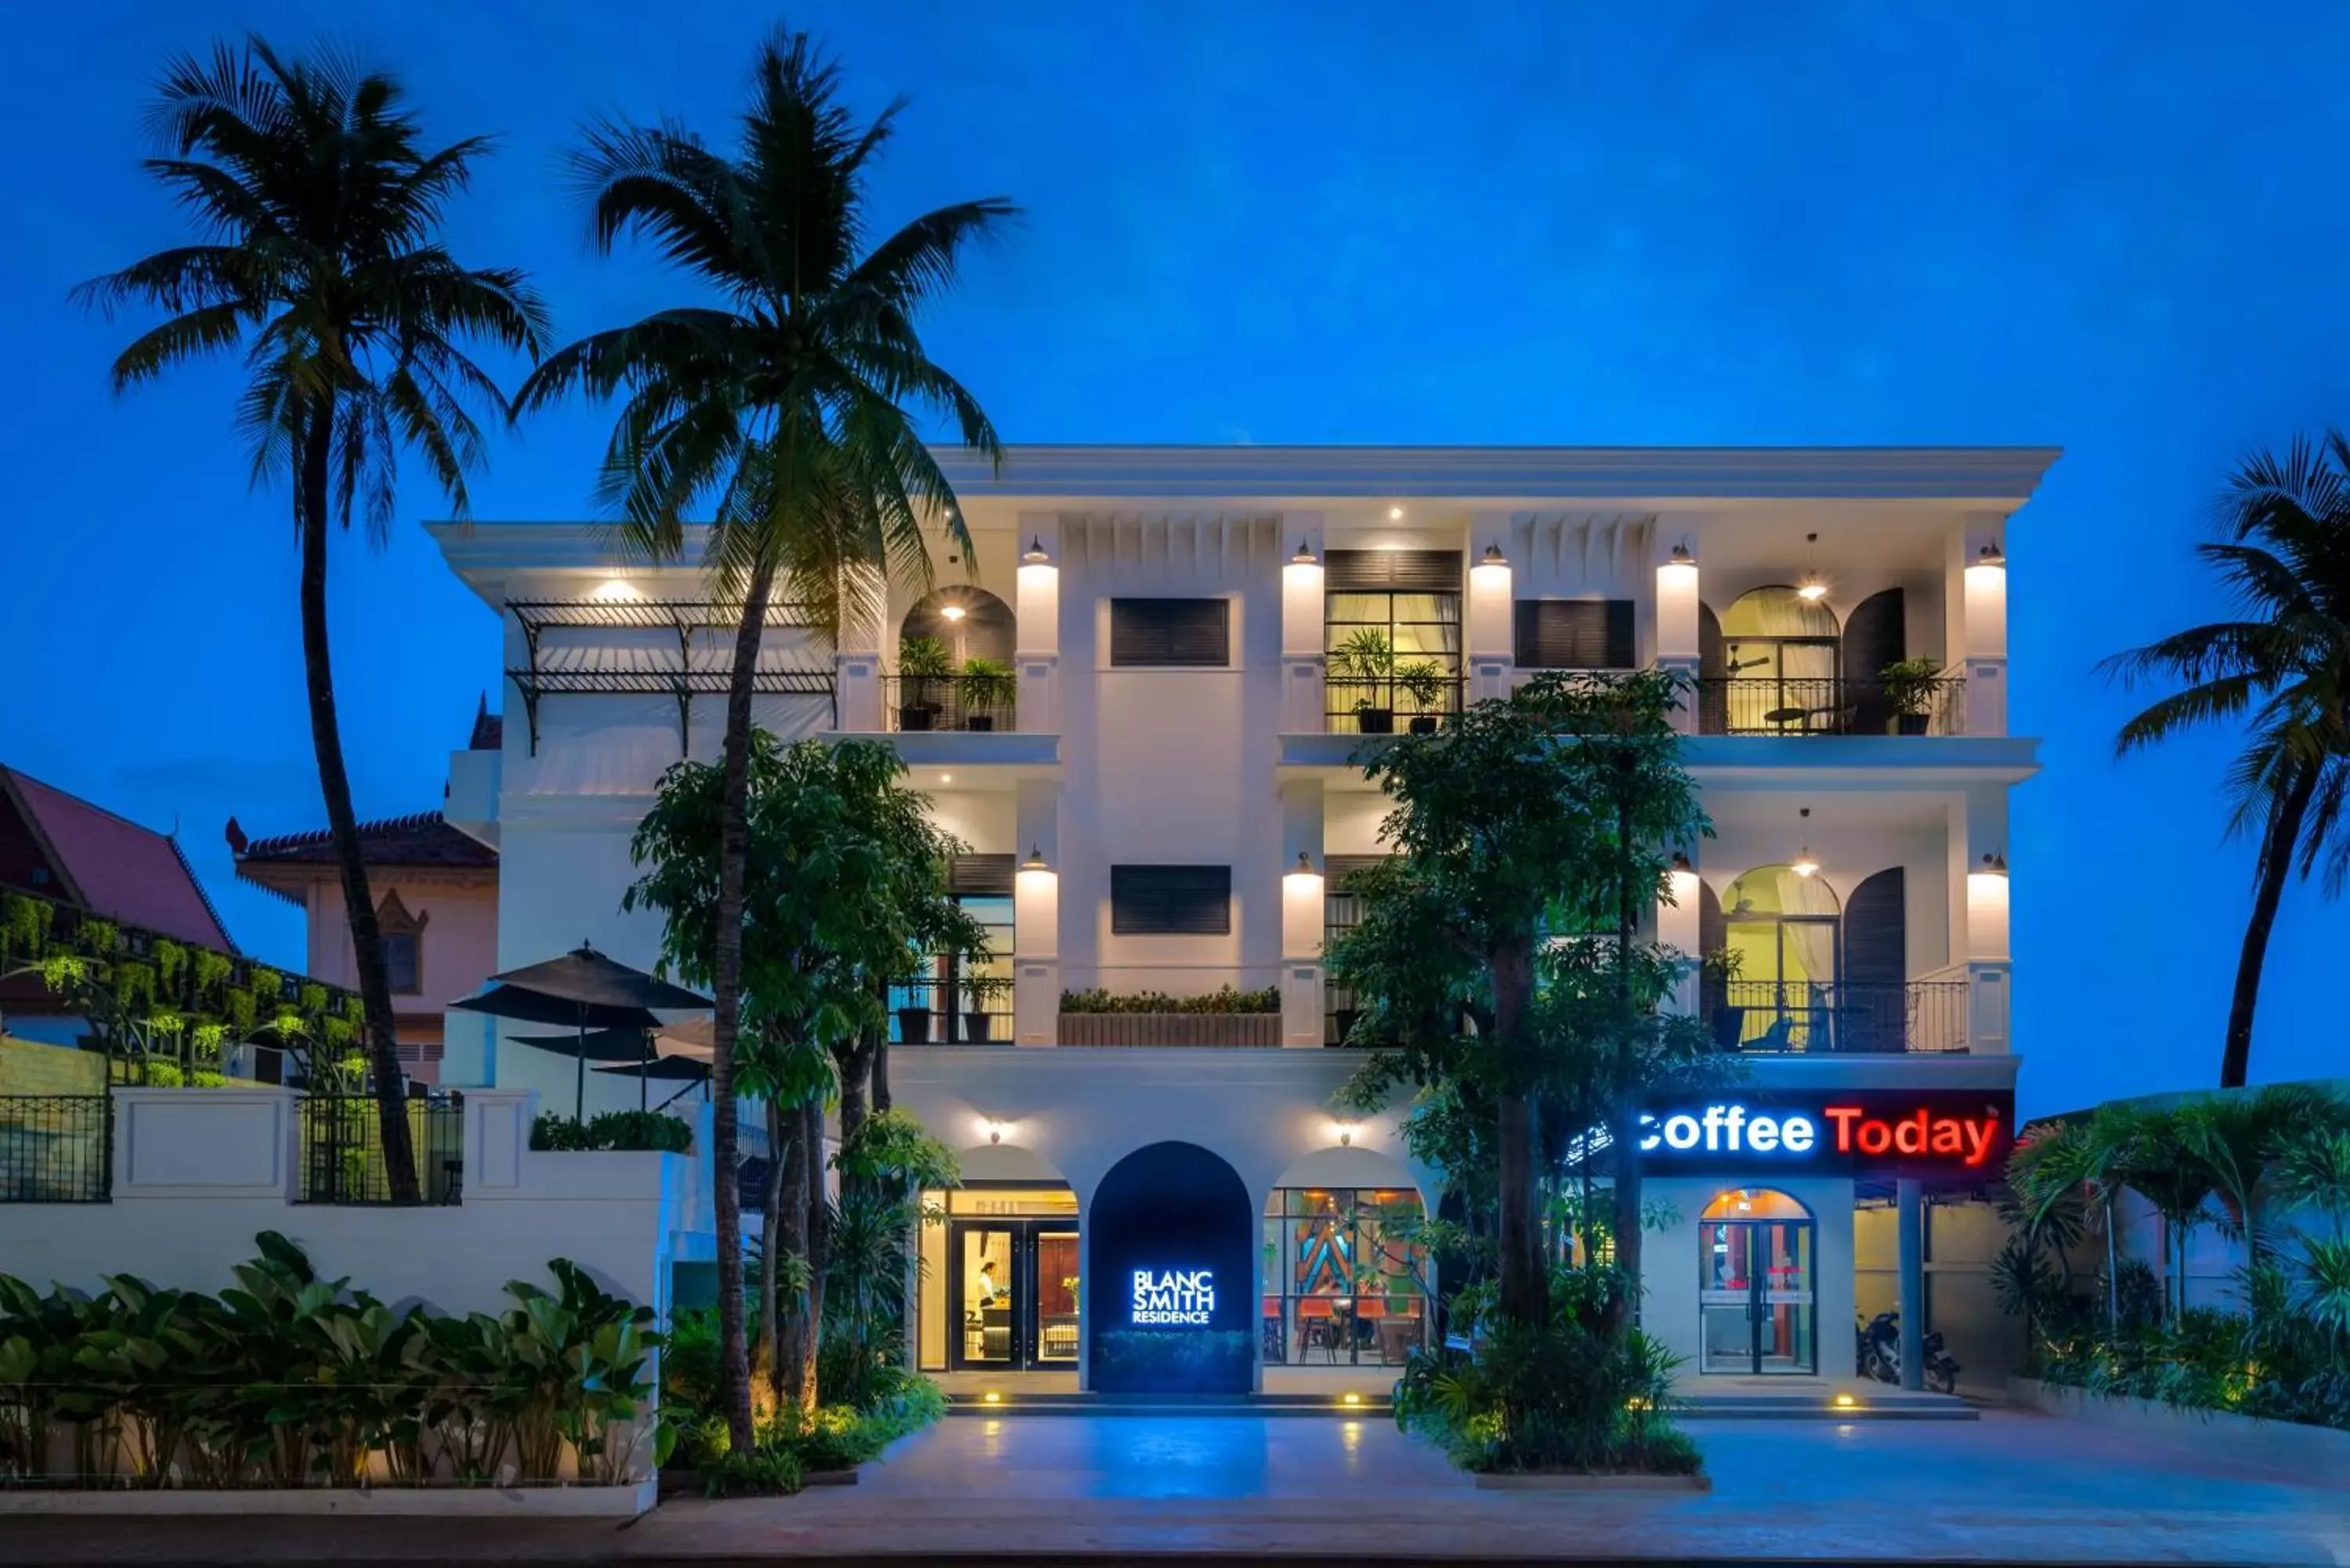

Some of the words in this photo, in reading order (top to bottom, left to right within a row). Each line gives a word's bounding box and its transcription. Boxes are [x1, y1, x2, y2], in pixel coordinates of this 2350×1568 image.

[1824, 1107, 1998, 1165] Today
[1133, 1270, 1213, 1292] BLANC
[1133, 1291, 1215, 1310] SMITH
[1133, 1311, 1209, 1324] RESIDENCE
